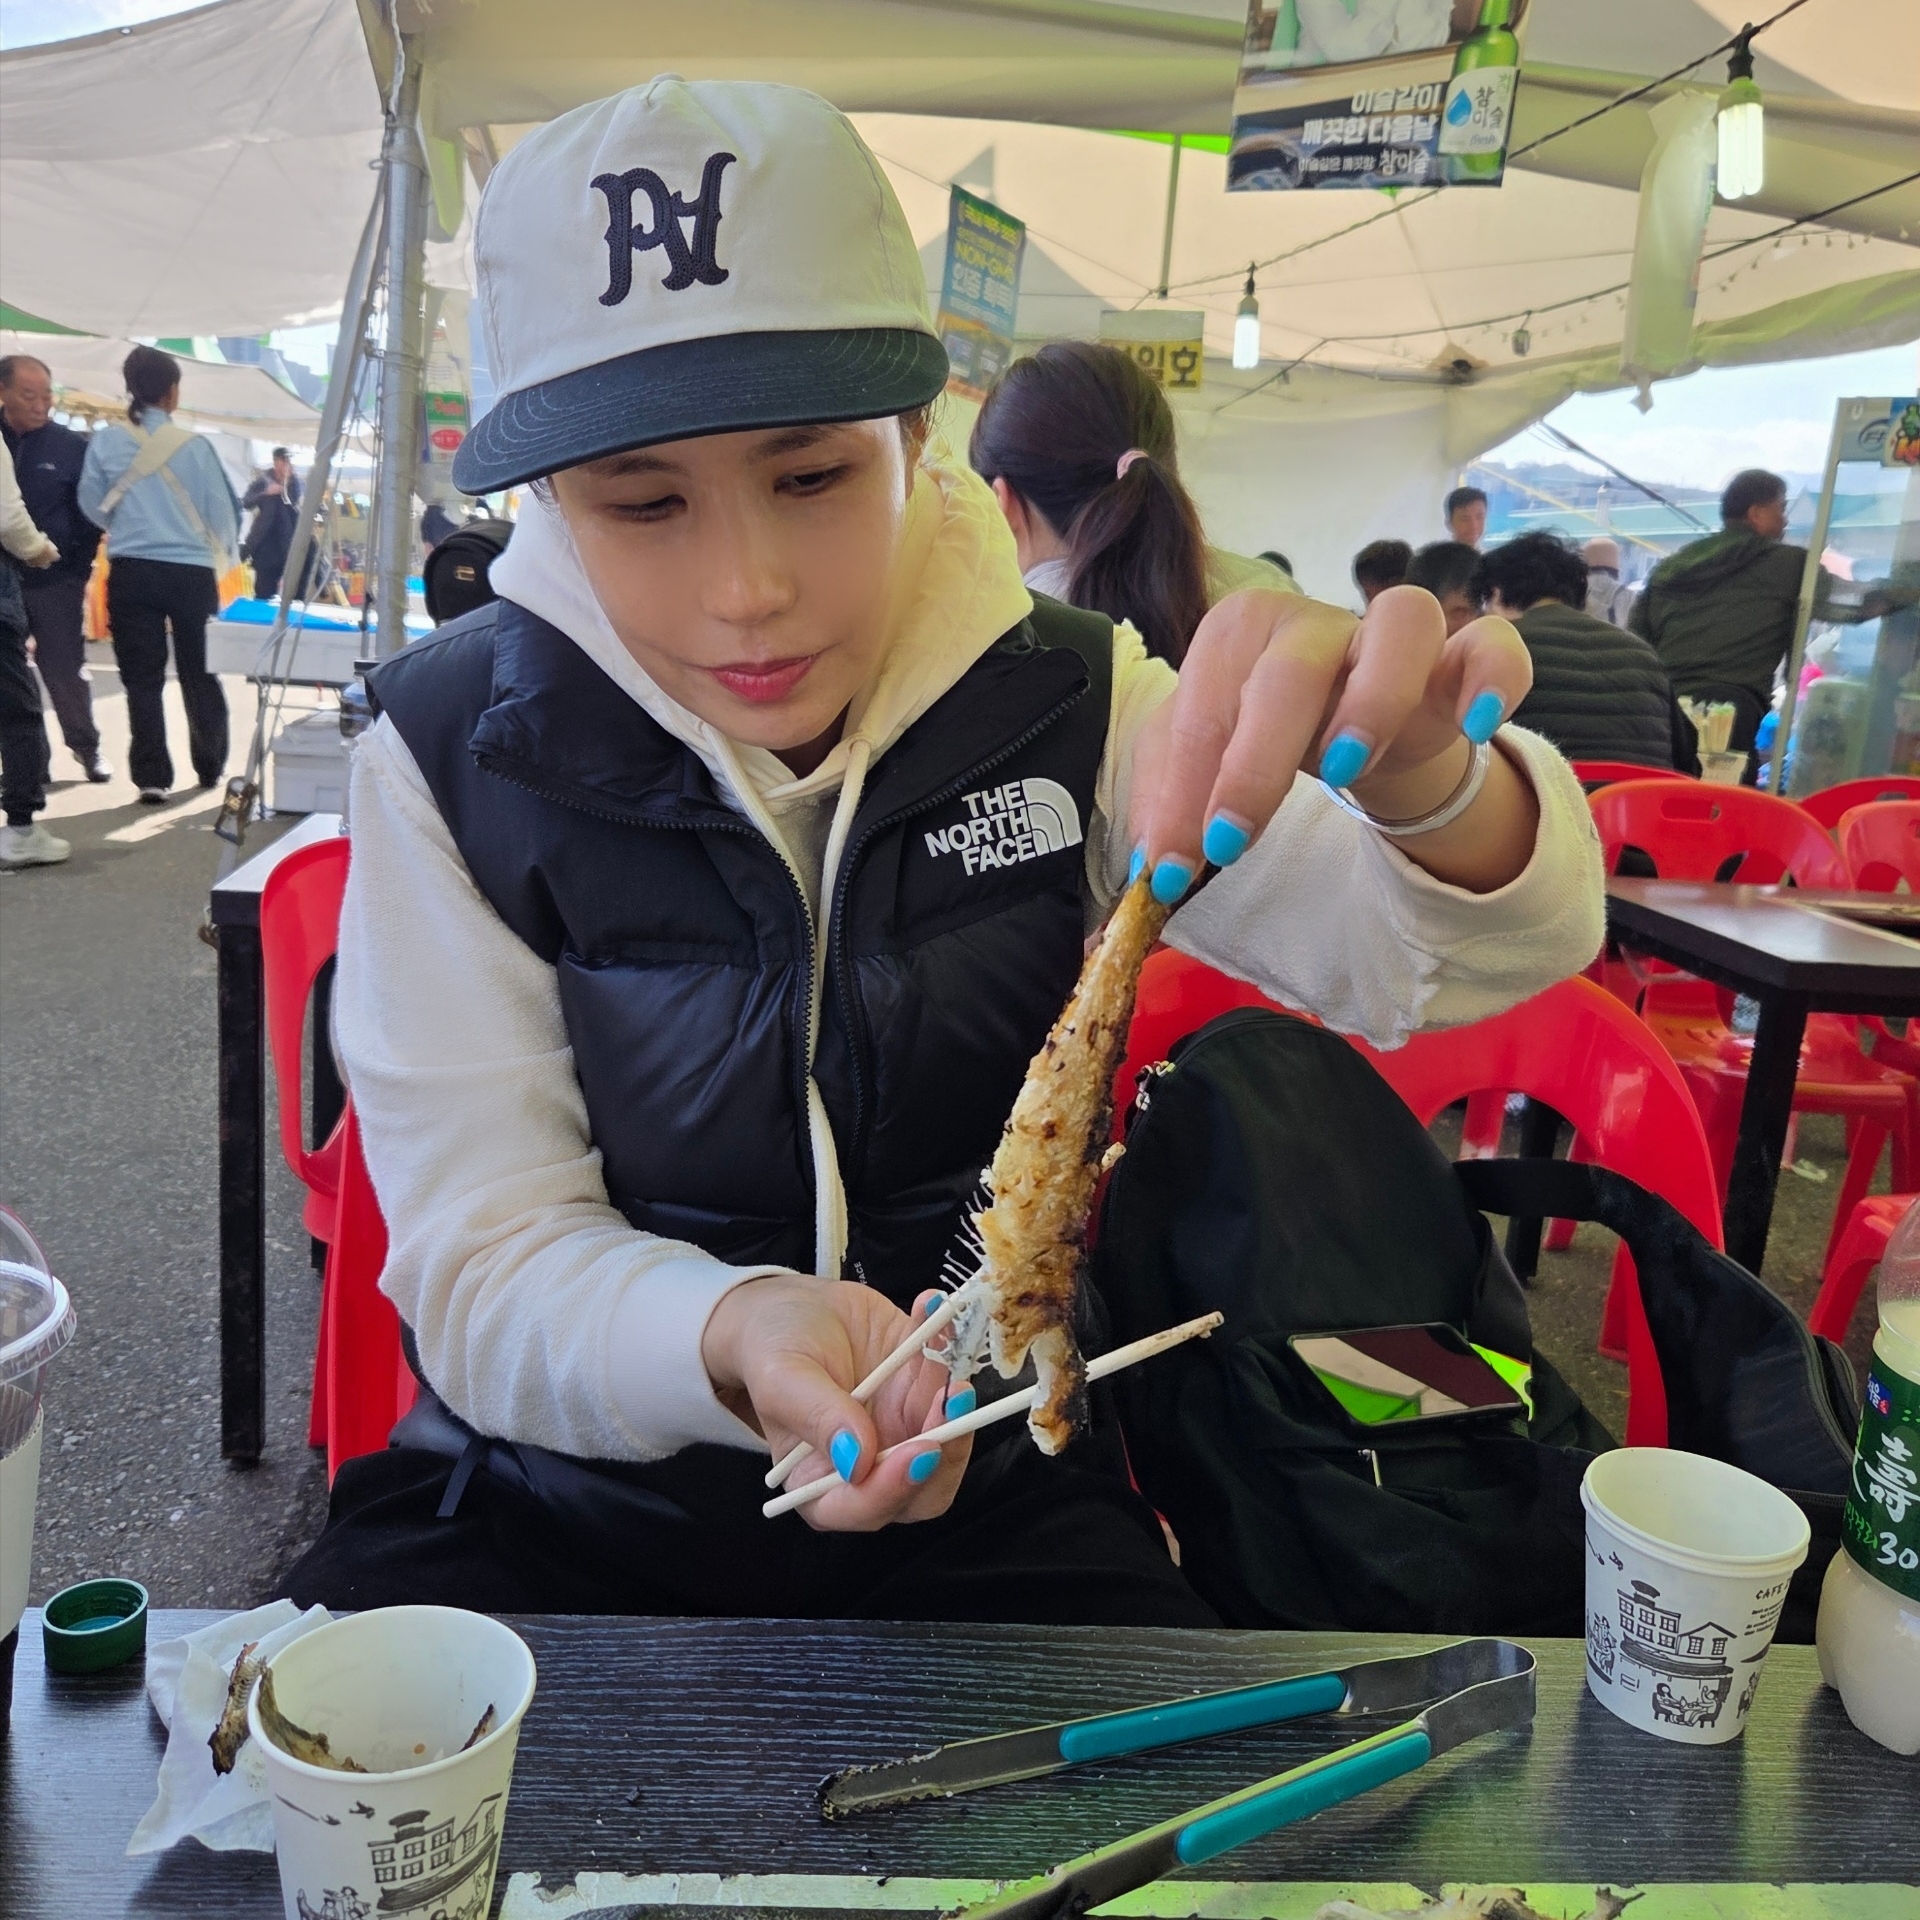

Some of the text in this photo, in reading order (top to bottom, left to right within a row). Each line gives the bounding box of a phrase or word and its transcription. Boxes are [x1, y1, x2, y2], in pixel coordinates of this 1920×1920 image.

[1351, 84, 1443, 114] 이슬같이
[1301, 113, 1440, 146] 깨끗한 다음날
[961, 781, 1026, 818] THE
[924, 806, 1032, 858] NORTH
[961, 832, 1037, 877] FACE
[1755, 1582, 1784, 1601] CAFE
